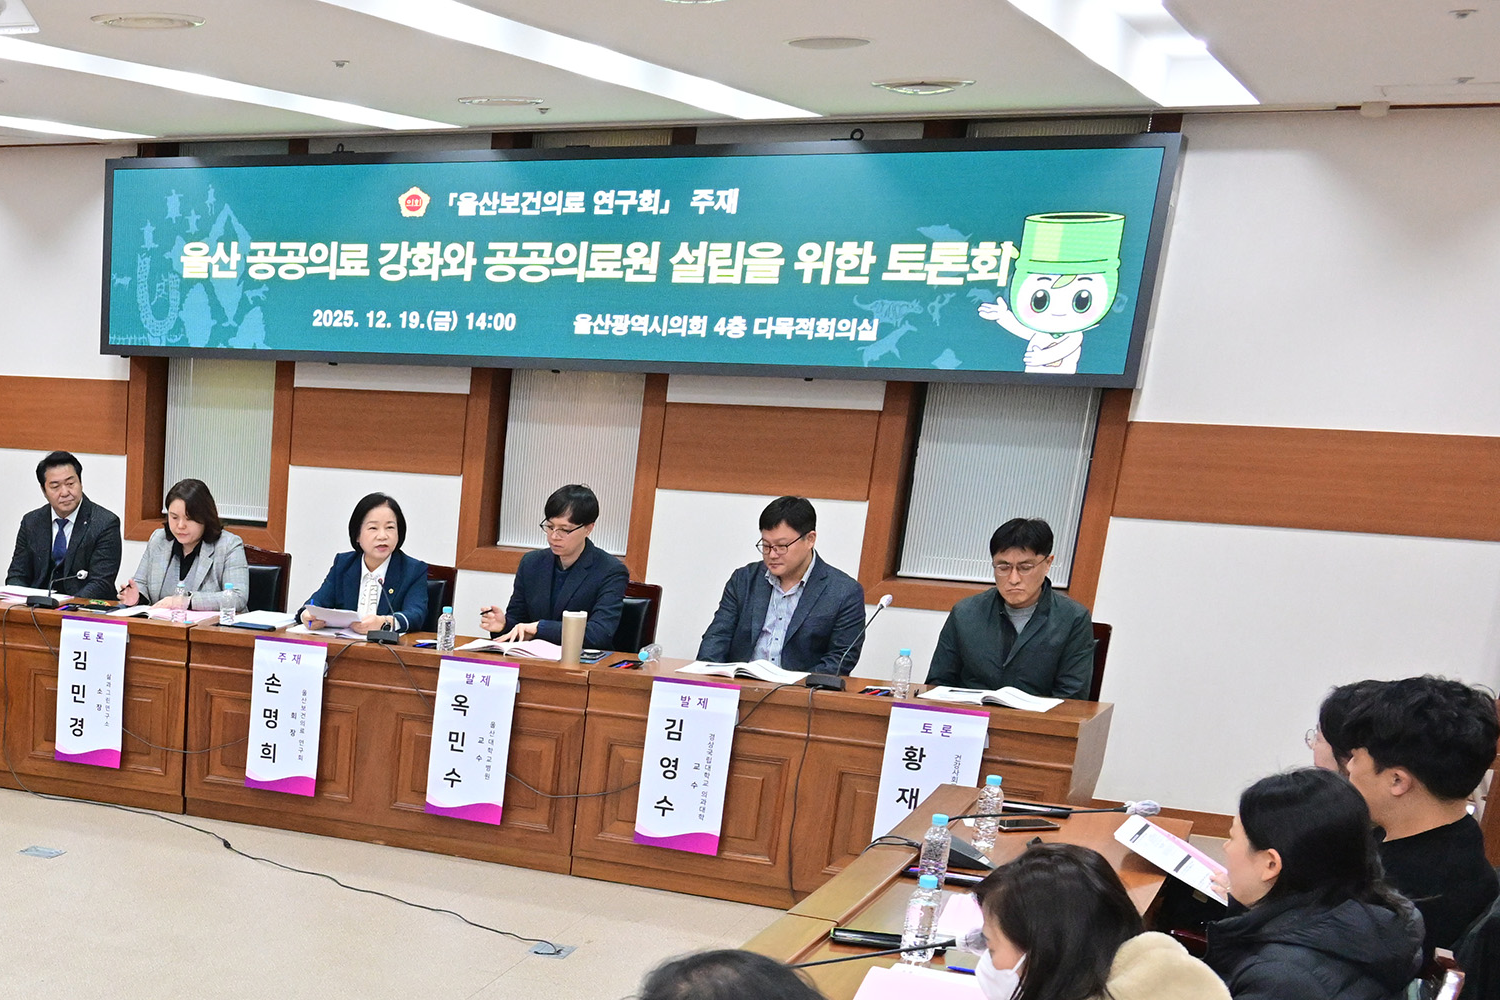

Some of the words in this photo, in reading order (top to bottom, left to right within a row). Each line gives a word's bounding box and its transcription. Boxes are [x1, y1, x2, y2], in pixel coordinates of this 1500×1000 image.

[690, 187, 740, 215] 주재
[180, 241, 242, 279] 울산
[246, 241, 370, 281] 공공의료
[378, 241, 478, 282] 강화와
[483, 241, 661, 284] 공공의료원
[669, 241, 785, 285] 설립을
[794, 240, 877, 286] 위한
[881, 241, 1016, 287] 토론회
[312, 309, 359, 328] 2025.
[366, 310, 392, 328] 12.
[399, 310, 458, 332] 19.(금)
[465, 312, 517, 331] 14:00
[573, 312, 708, 338] 울산광역시의회
[713, 315, 748, 339] 4층
[753, 316, 879, 341] 다목적회의실
[82, 631, 104, 643] 토론
[277, 652, 302, 665] 주재
[69, 650, 88, 738] 김민경
[465, 673, 491, 687] 발제
[680, 695, 709, 710] 발제
[259, 672, 282, 764] 손명희
[920, 722, 953, 738] 토론
[442, 694, 470, 789] 옥민수
[653, 718, 684, 818] 김영수
